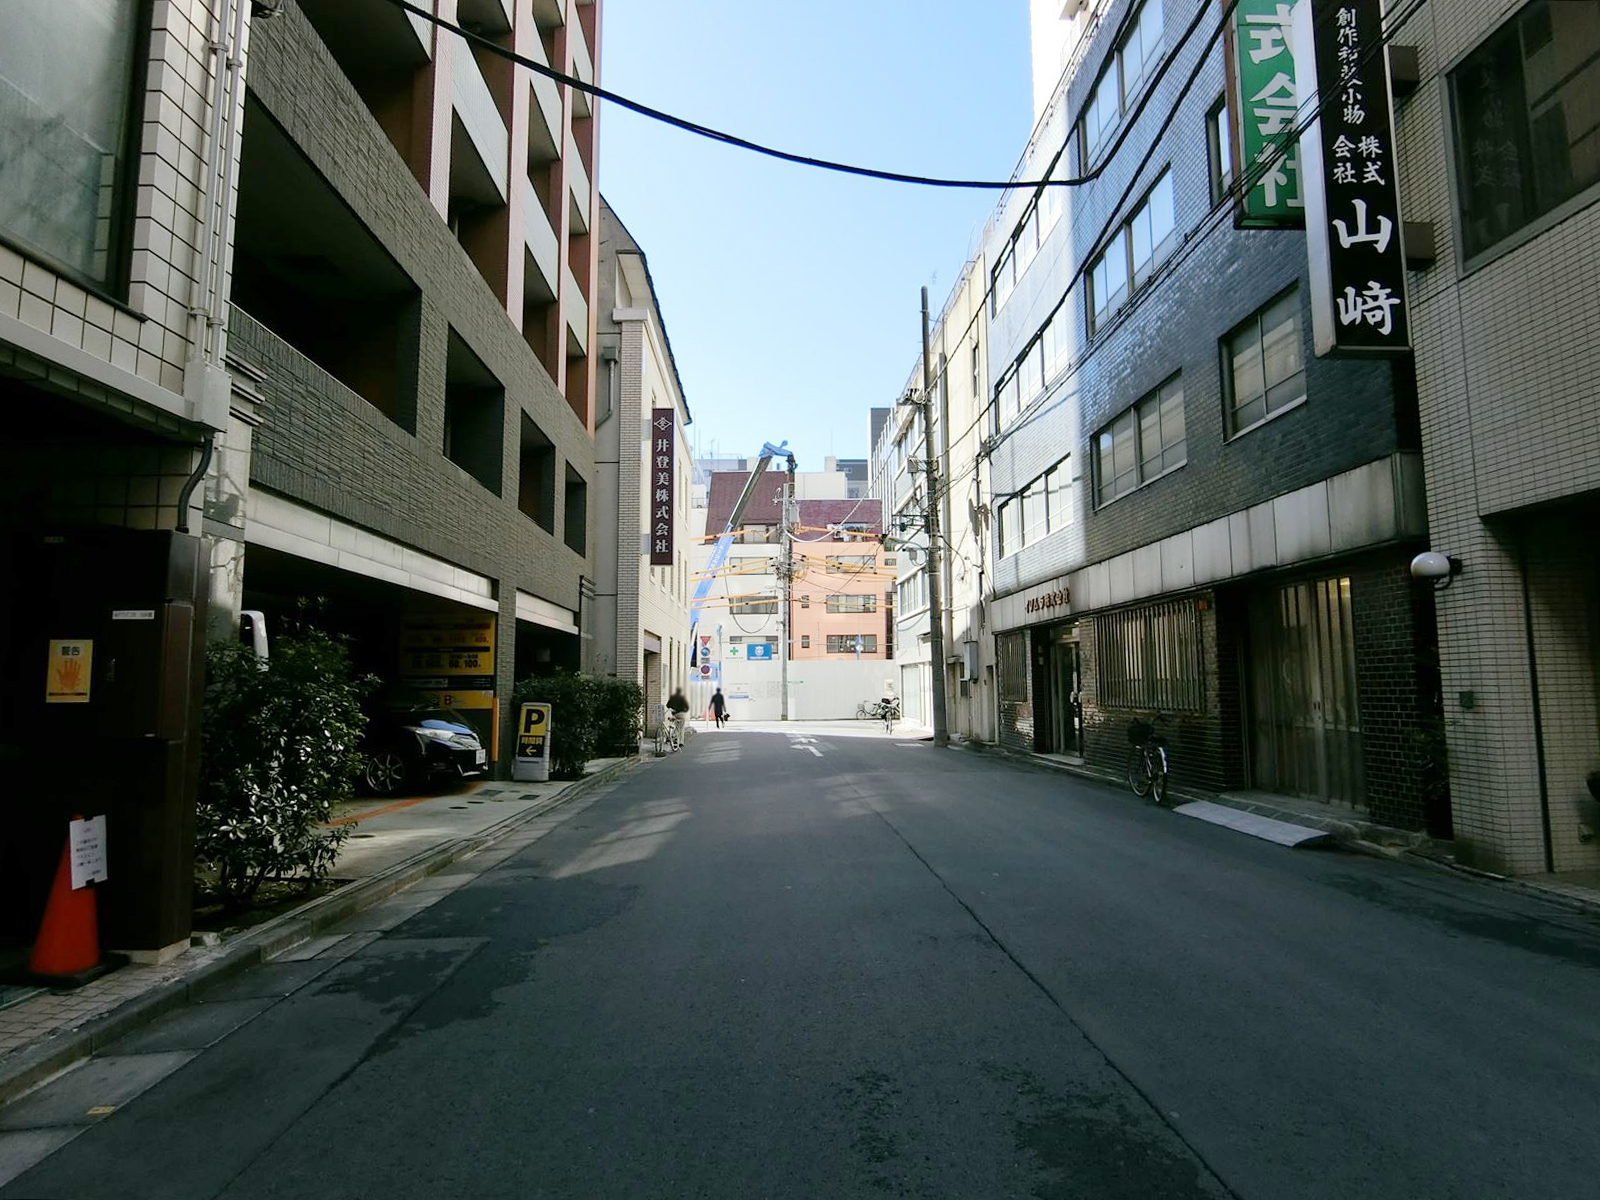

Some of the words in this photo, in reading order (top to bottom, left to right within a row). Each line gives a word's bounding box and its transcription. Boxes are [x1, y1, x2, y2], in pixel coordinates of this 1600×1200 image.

[655, 438, 670, 553] 井登美株式会社
[524, 709, 545, 733] P
